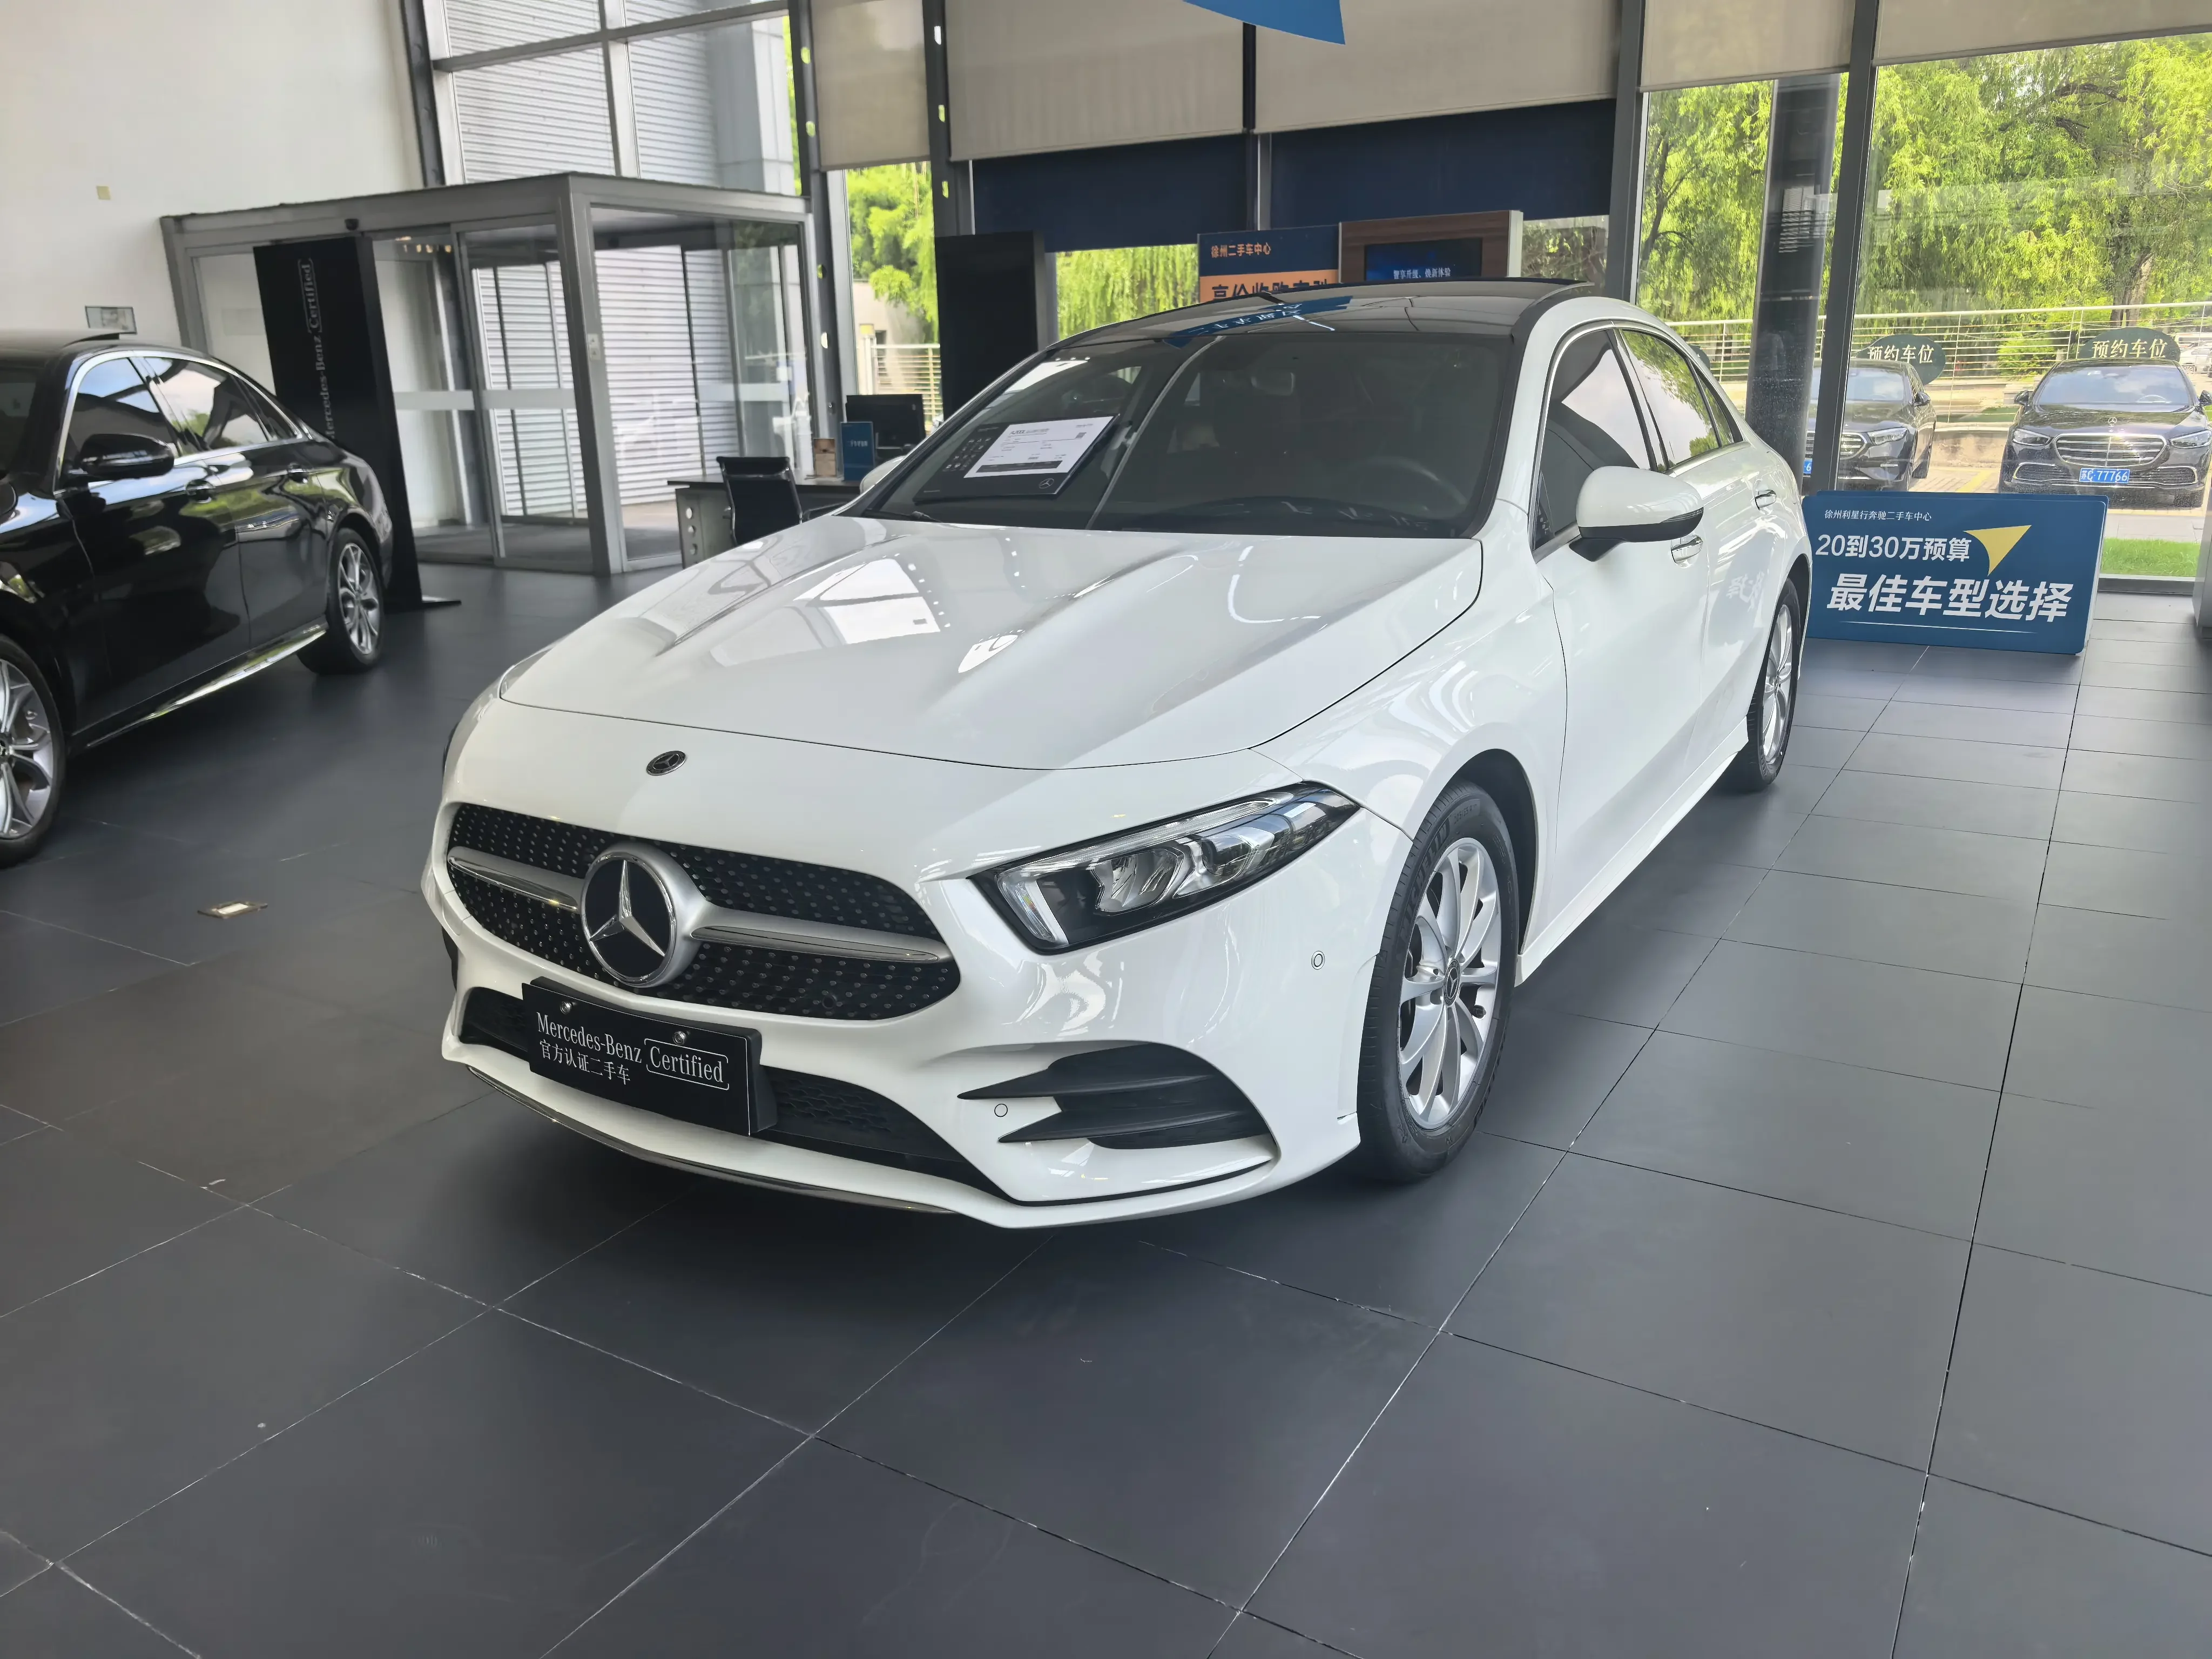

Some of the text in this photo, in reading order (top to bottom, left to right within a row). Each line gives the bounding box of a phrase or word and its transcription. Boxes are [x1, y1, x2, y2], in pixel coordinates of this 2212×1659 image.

[301, 263, 335, 439] ercedes-Benz Certified
[1867, 343, 1934, 364] 预约车位
[2092, 338, 2168, 359] 预约车位
[1824, 509, 1932, 521] 徐州利星行奔驰二手车中心
[1815, 534, 1971, 562] 20到30万预算
[1826, 573, 2074, 623] 最佳车型选择
[537, 1011, 724, 1083] Mercedes-Benz Certified
[539, 1038, 631, 1085] 官方认证二手车
